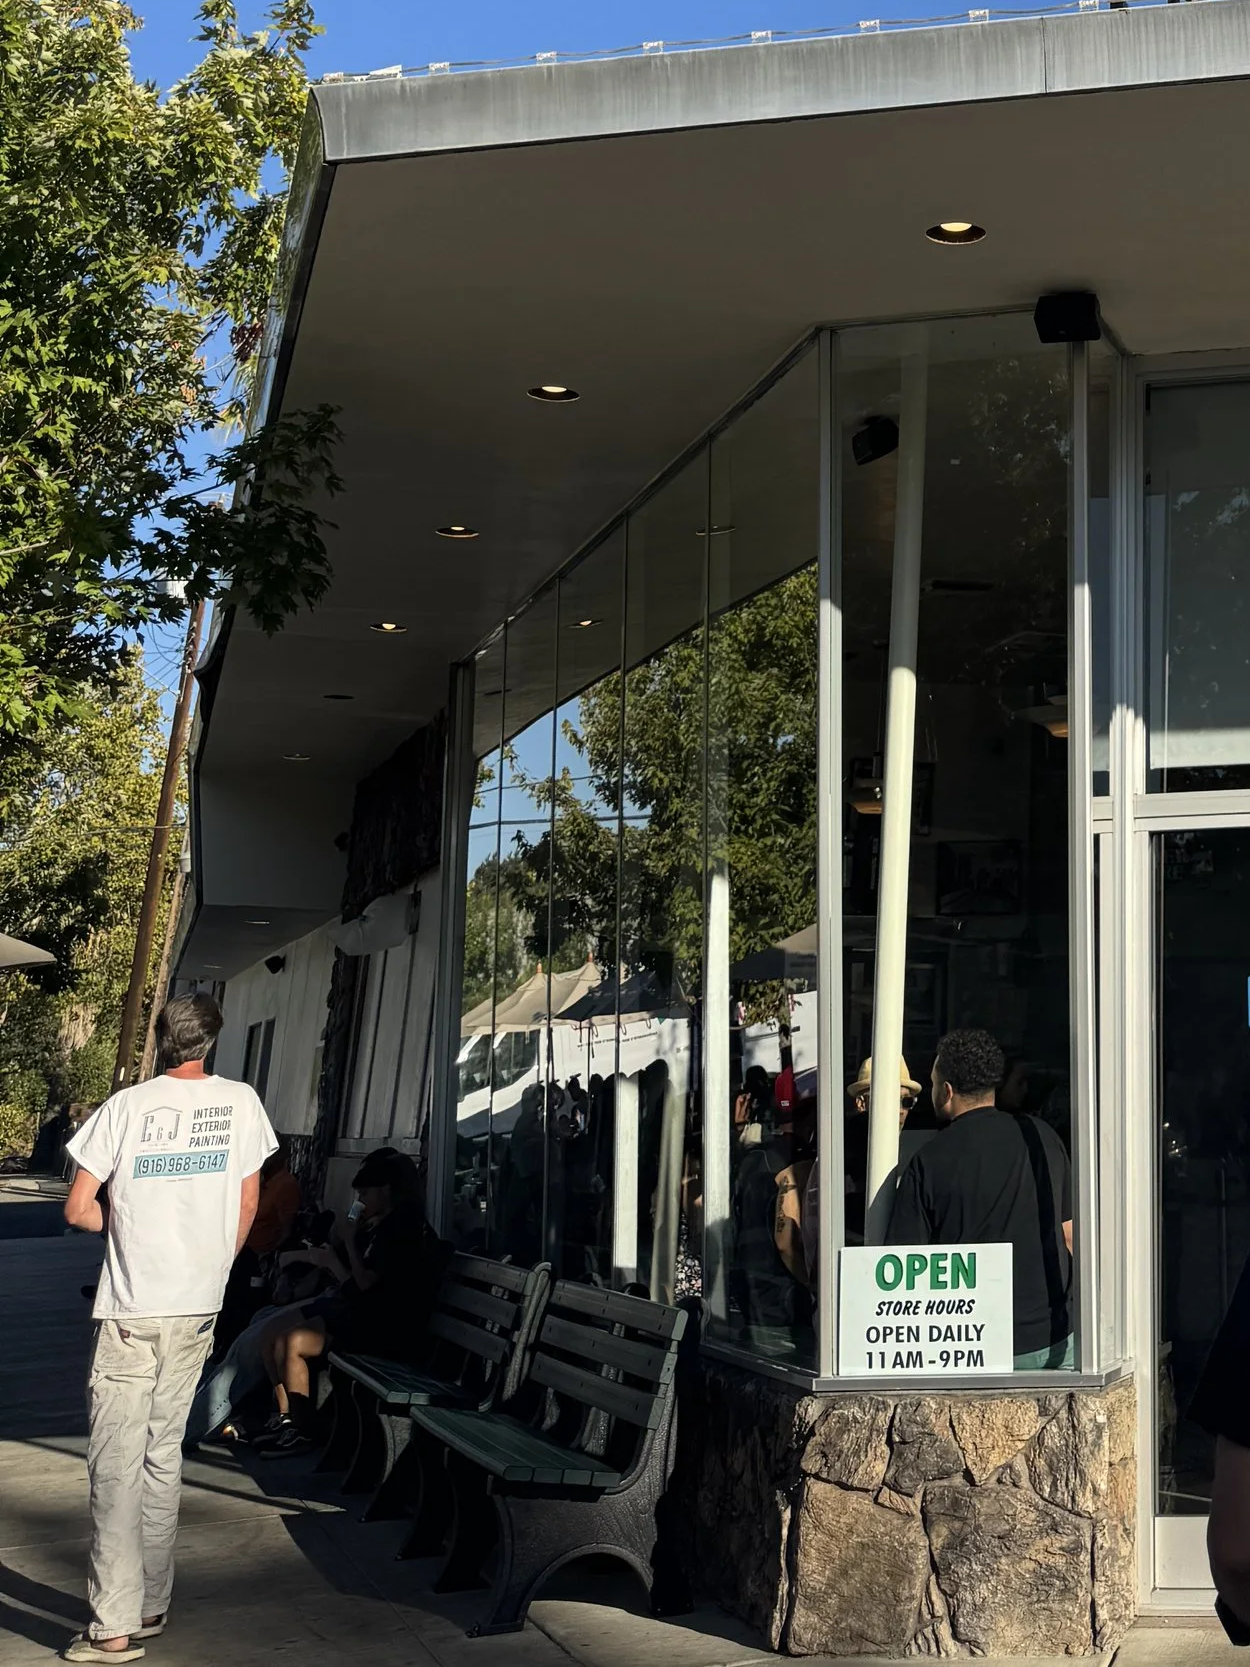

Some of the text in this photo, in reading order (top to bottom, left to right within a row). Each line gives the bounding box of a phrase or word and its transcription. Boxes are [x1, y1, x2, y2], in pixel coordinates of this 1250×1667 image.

[193, 1105, 233, 1120] INTERIOR
[168, 1113, 180, 1140] J
[189, 1134, 230, 1148] PAINTING
[875, 1252, 976, 1291] OPEN
[875, 1299, 975, 1316] STORE HOURS
[866, 1324, 985, 1343] OPEN DAILY
